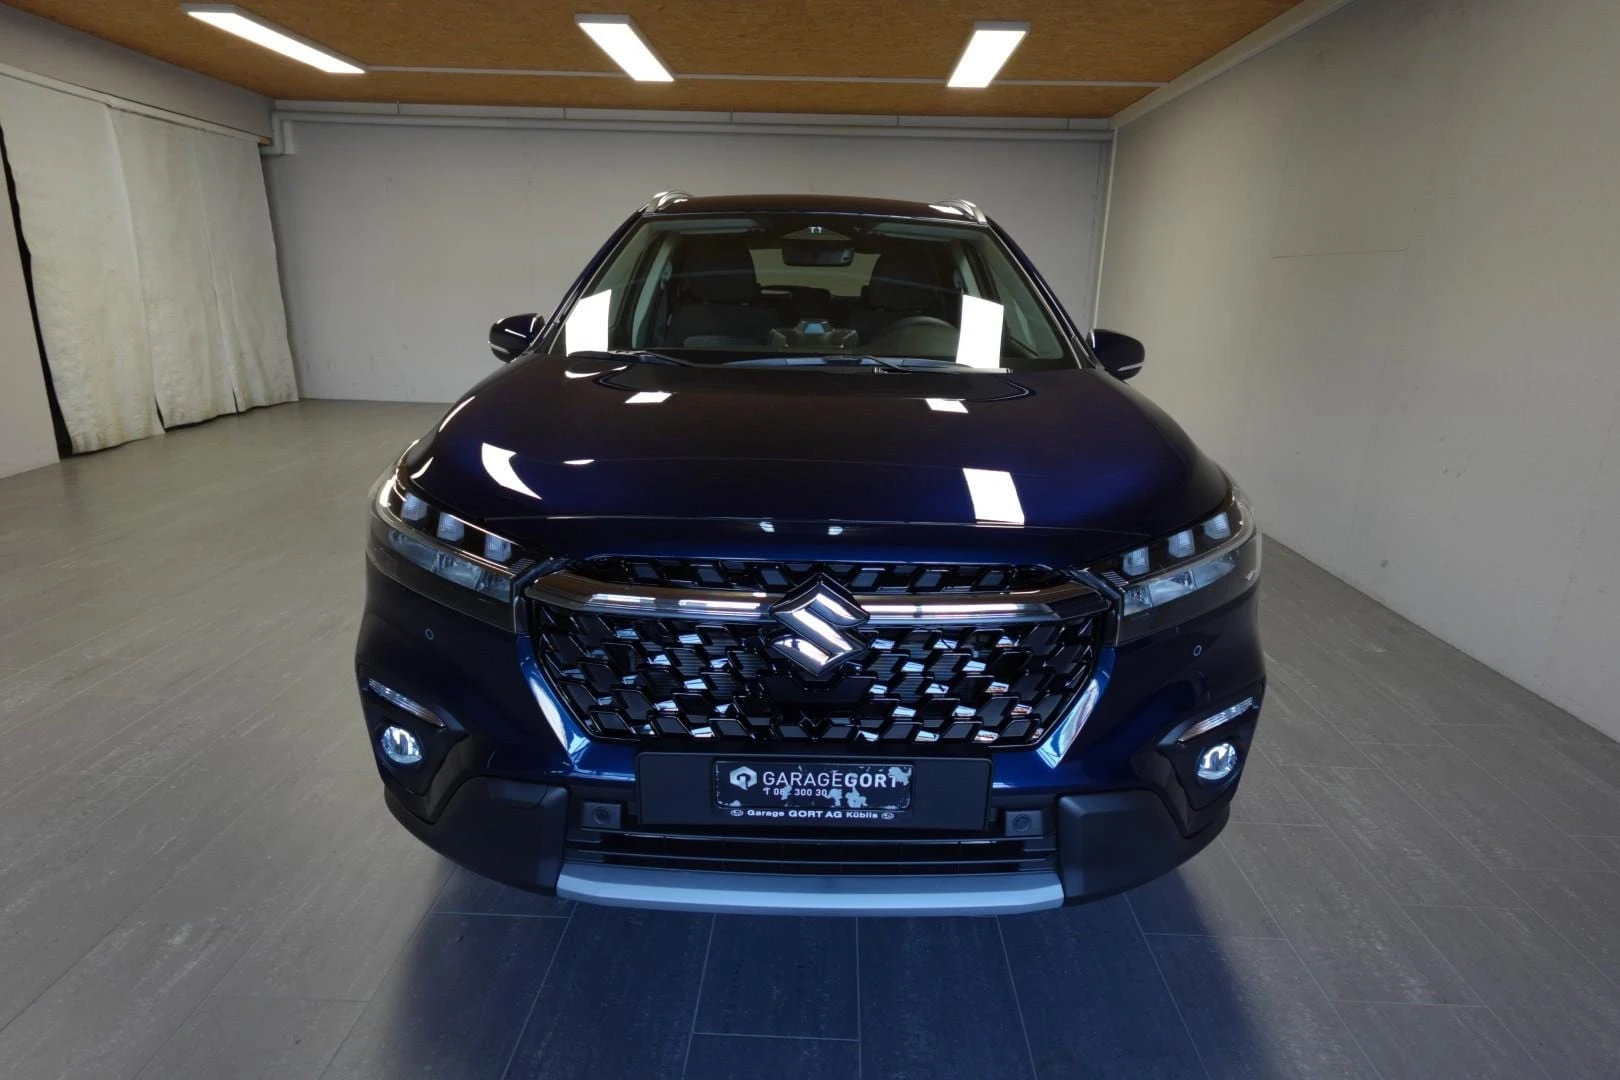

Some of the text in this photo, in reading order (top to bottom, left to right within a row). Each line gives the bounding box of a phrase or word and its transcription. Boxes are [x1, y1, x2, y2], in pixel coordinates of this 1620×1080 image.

[794, 788, 813, 797] 300
[747, 809, 785, 818] Garage
[788, 810, 823, 818] GORT
[825, 811, 842, 819] AG
